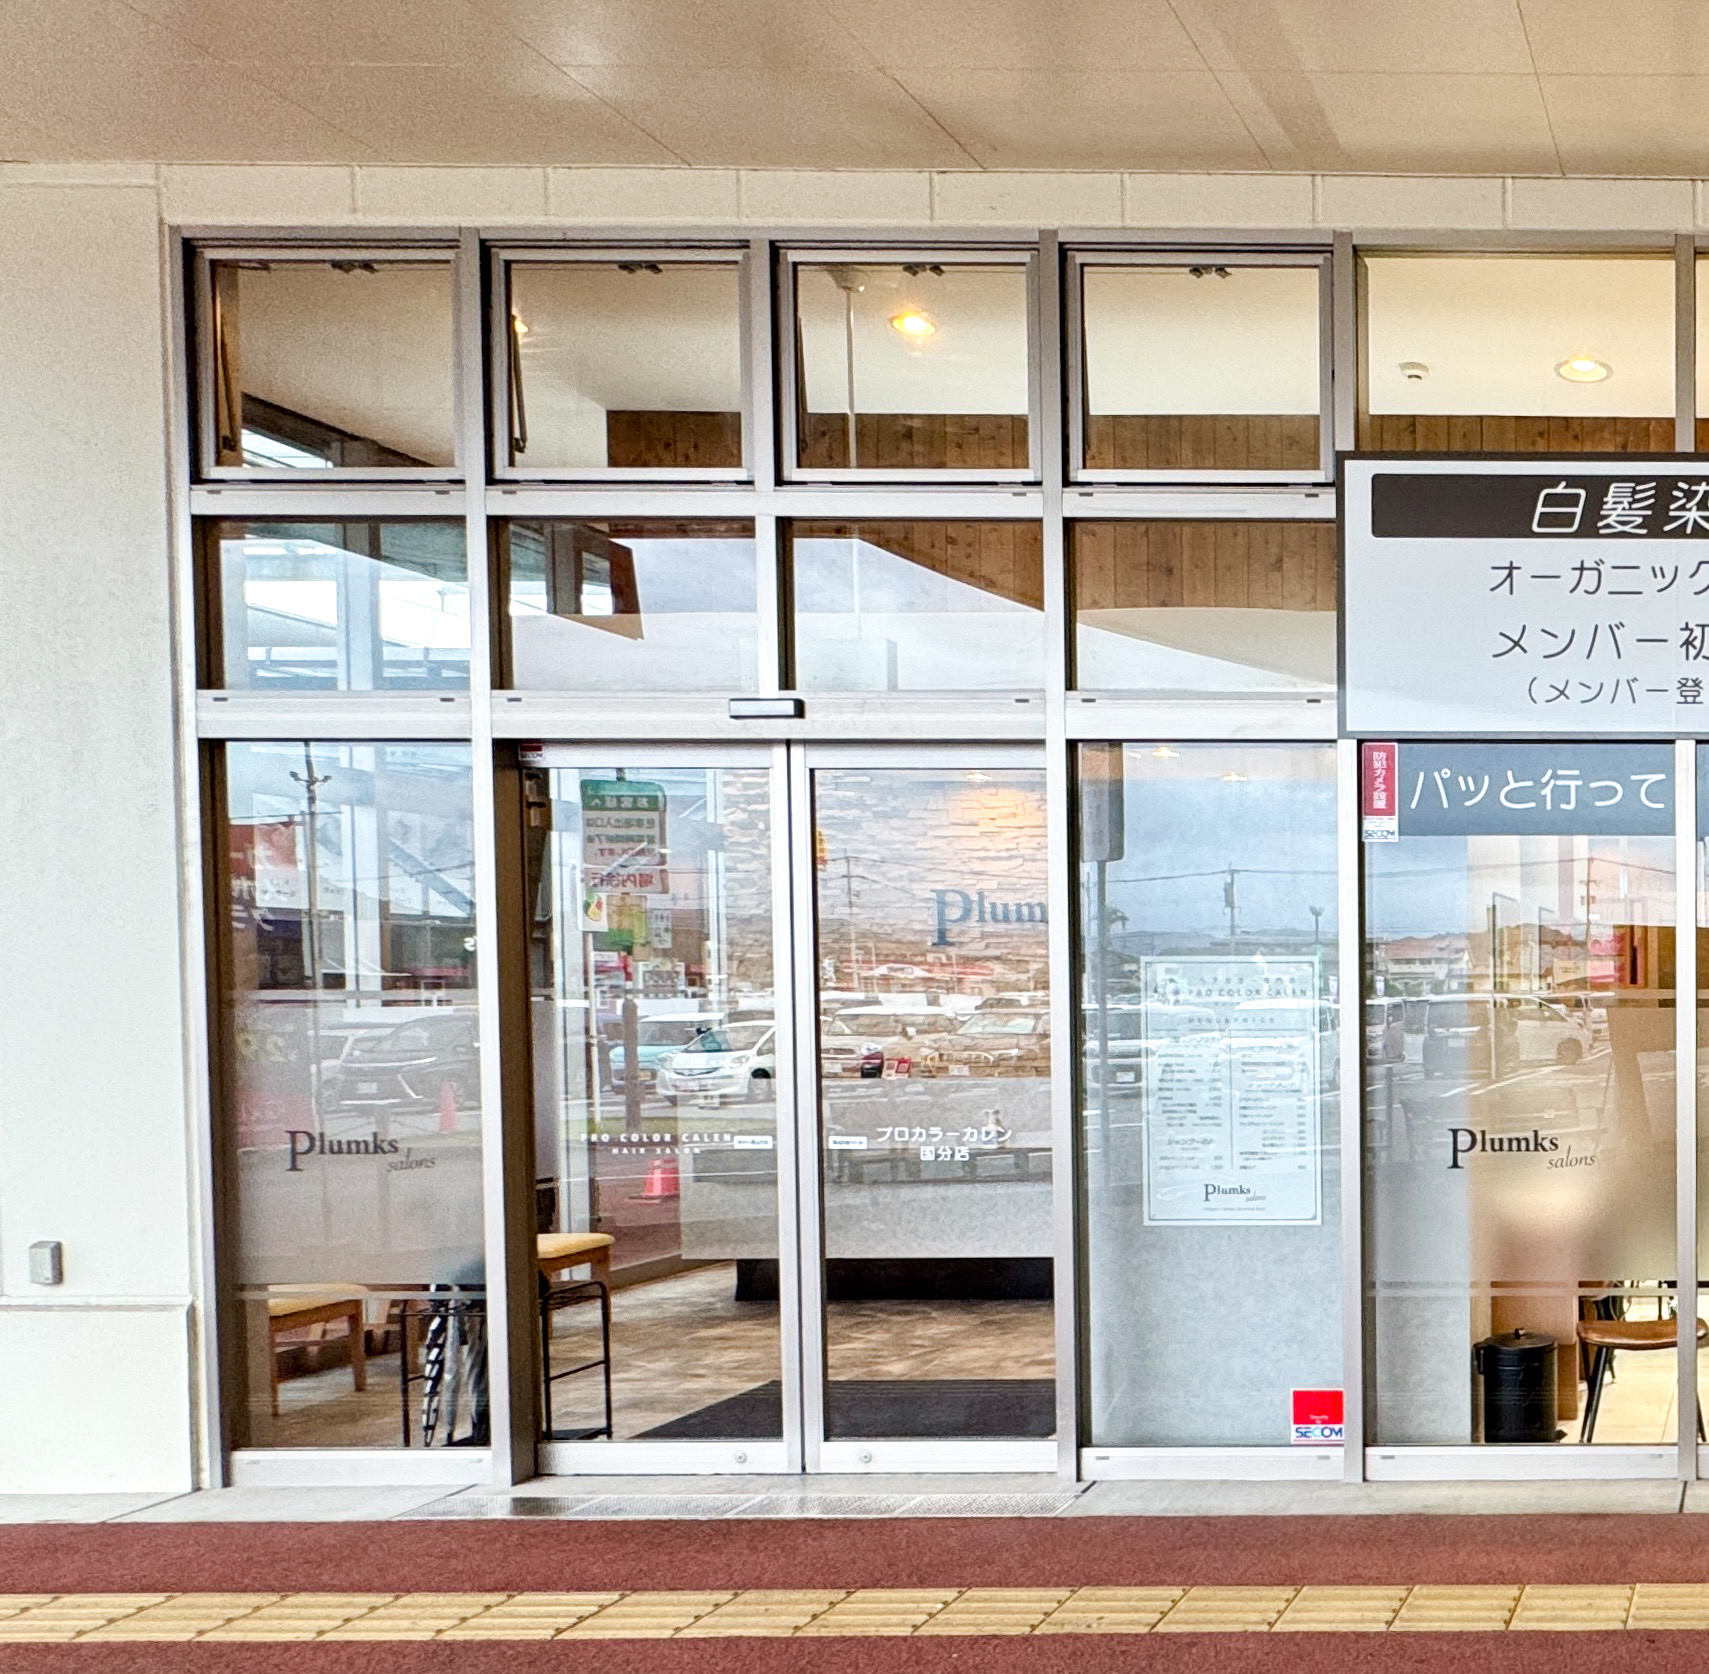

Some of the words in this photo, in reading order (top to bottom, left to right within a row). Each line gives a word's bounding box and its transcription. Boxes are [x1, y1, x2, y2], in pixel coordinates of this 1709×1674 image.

[1410, 769, 1667, 811] パッと行って
[580, 1133, 611, 1142] PRO
[620, 1133, 672, 1142] COLOR
[682, 1132, 731, 1142] CALEN
[876, 1126, 1012, 1142] プロカラーカレン
[285, 1130, 399, 1173] Plumks
[920, 1145, 970, 1161] 国分店
[1447, 1127, 1559, 1169] Plumks
[1547, 1145, 1597, 1170] salons
[387, 1147, 436, 1172] salons
[1203, 1183, 1252, 1202] Plumks
[1295, 1427, 1343, 1438] SECOM
